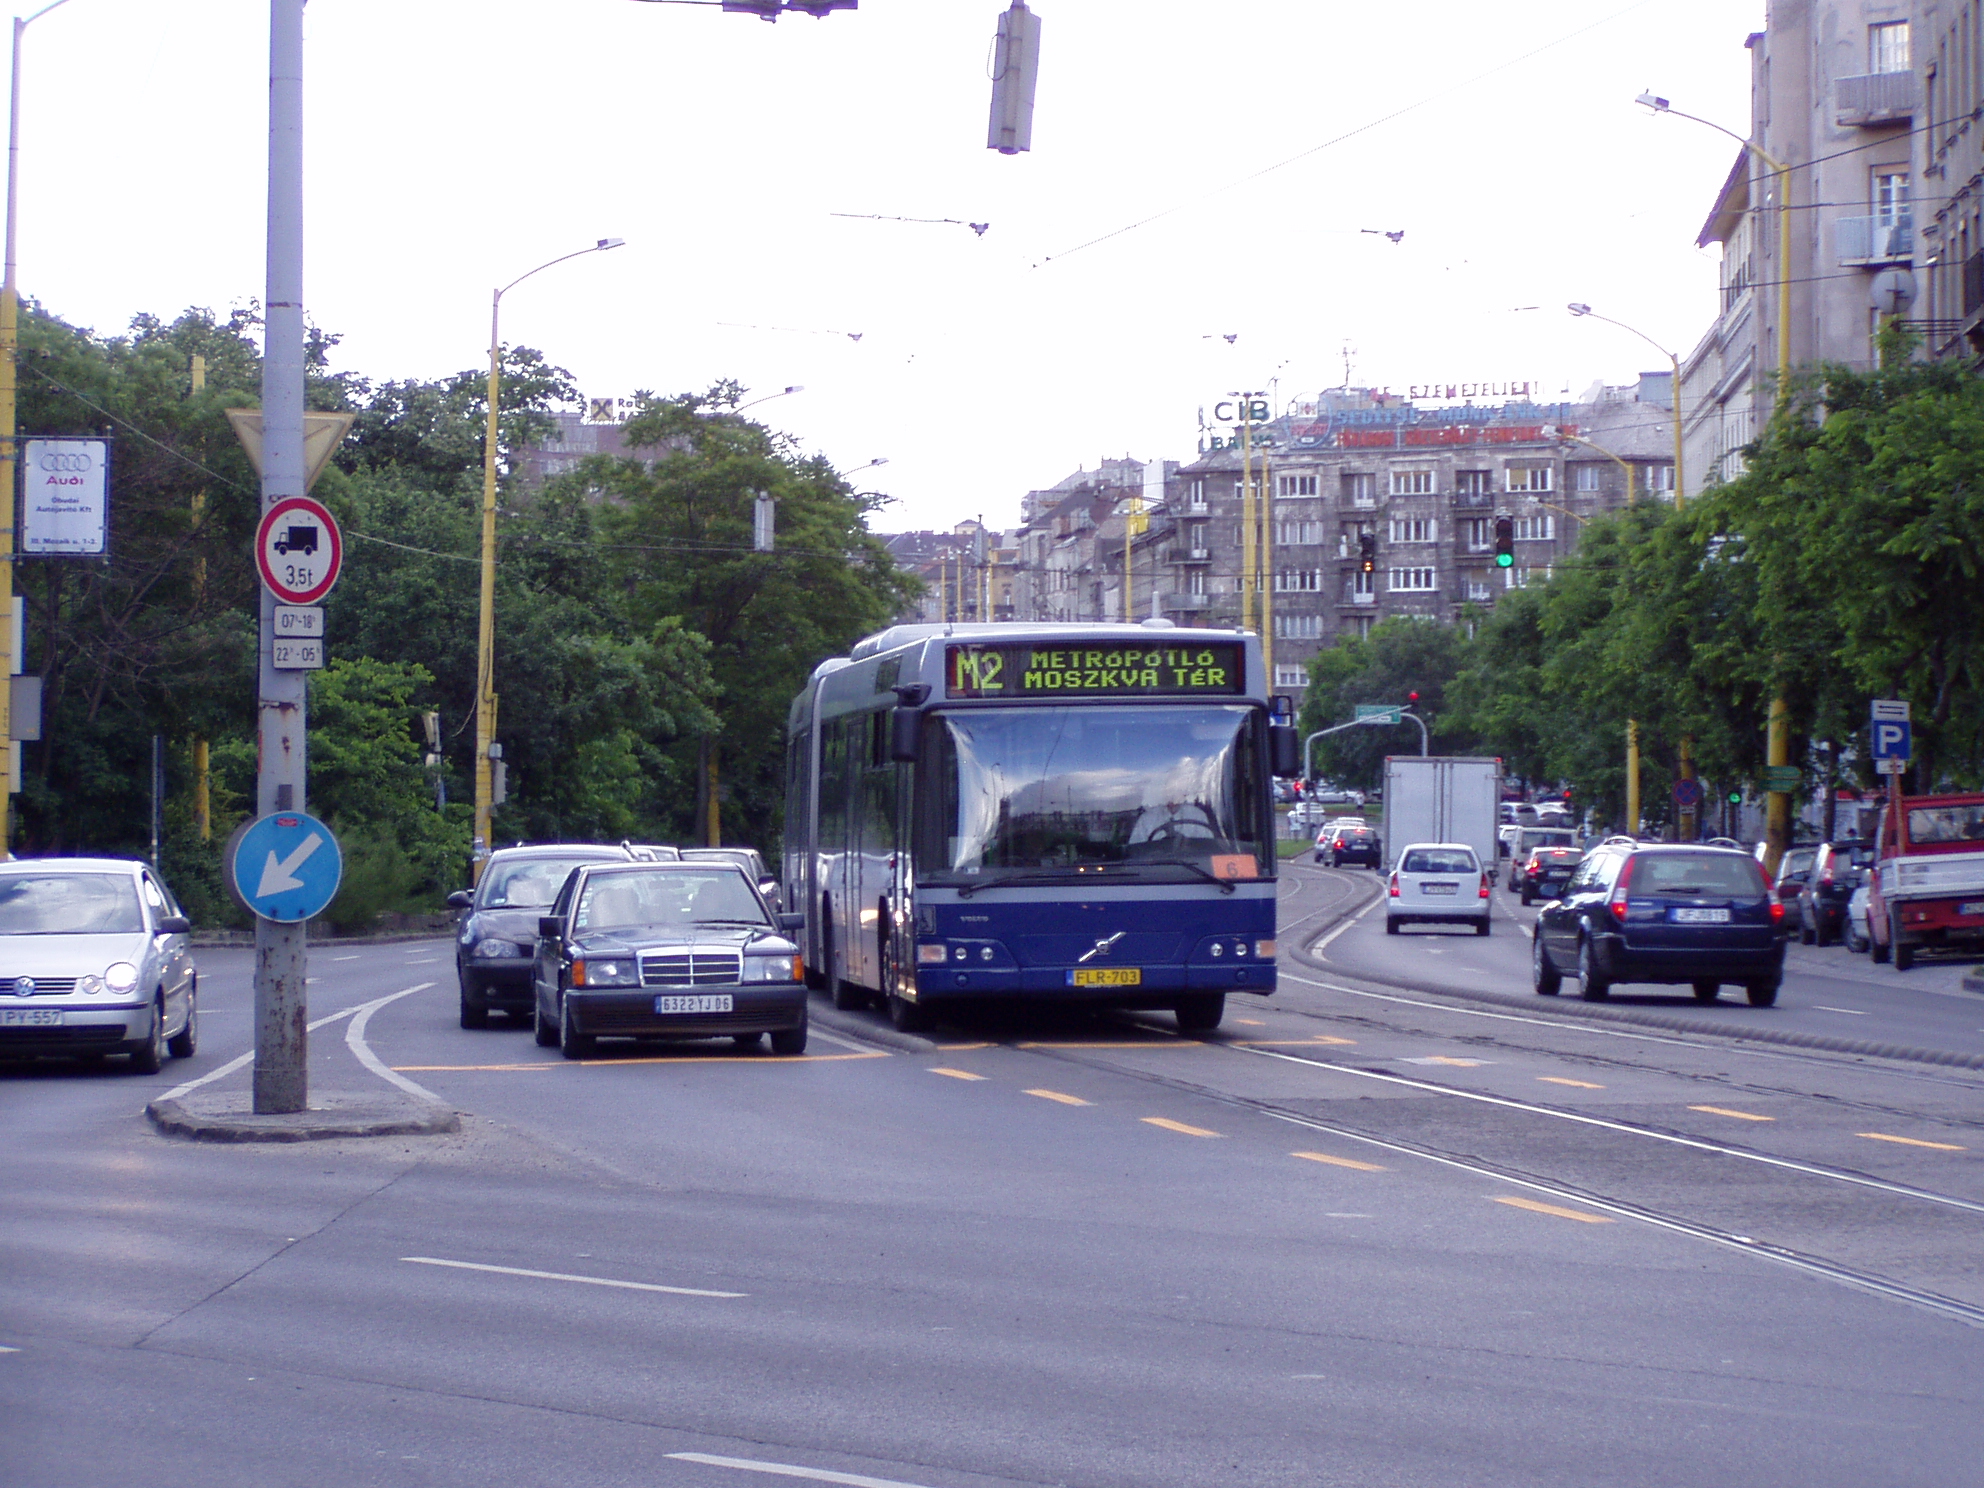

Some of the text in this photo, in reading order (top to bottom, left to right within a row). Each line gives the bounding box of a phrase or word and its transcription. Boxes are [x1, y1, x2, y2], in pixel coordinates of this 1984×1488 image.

[1214, 400, 1270, 421] CIB
[46, 476, 84, 485] Audi
[286, 565, 313, 586] 3,5t
[957, 650, 1215, 690] M2 METRÓPÓTLÓ
[1025, 668, 1226, 688] MOSZKVA TÉR
[1879, 725, 1903, 753] P
[1227, 861, 1238, 877] 6
[1076, 971, 1137, 984] FLR-703
[0, 1011, 60, 1024] PY-557
